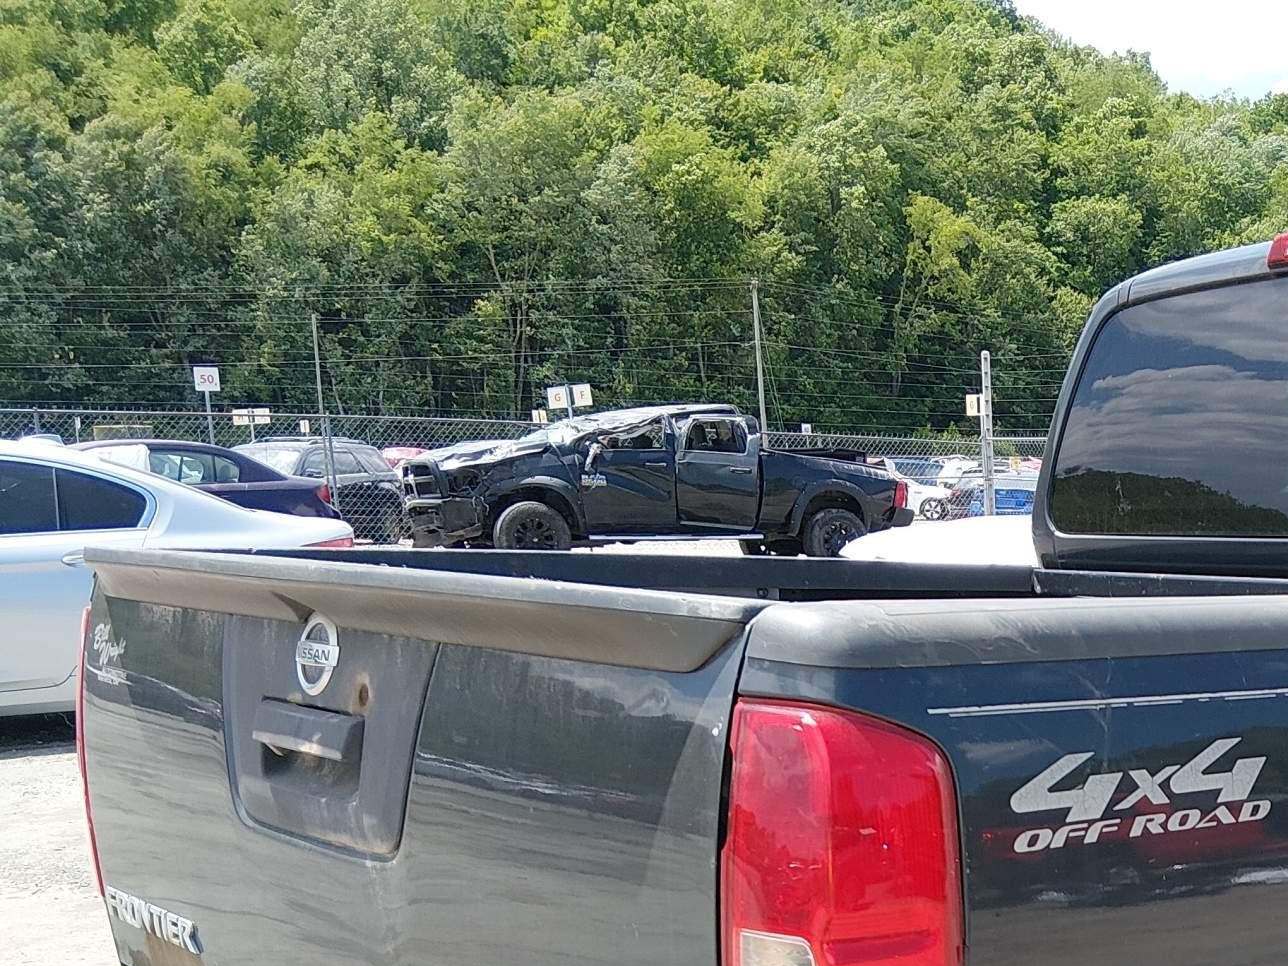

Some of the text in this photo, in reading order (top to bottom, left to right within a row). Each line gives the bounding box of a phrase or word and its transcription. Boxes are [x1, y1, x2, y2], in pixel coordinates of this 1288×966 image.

[199, 374, 215, 385] 50
[1013, 799, 1272, 853] OFF ROAD
[105, 885, 201, 955] FRONTIER
